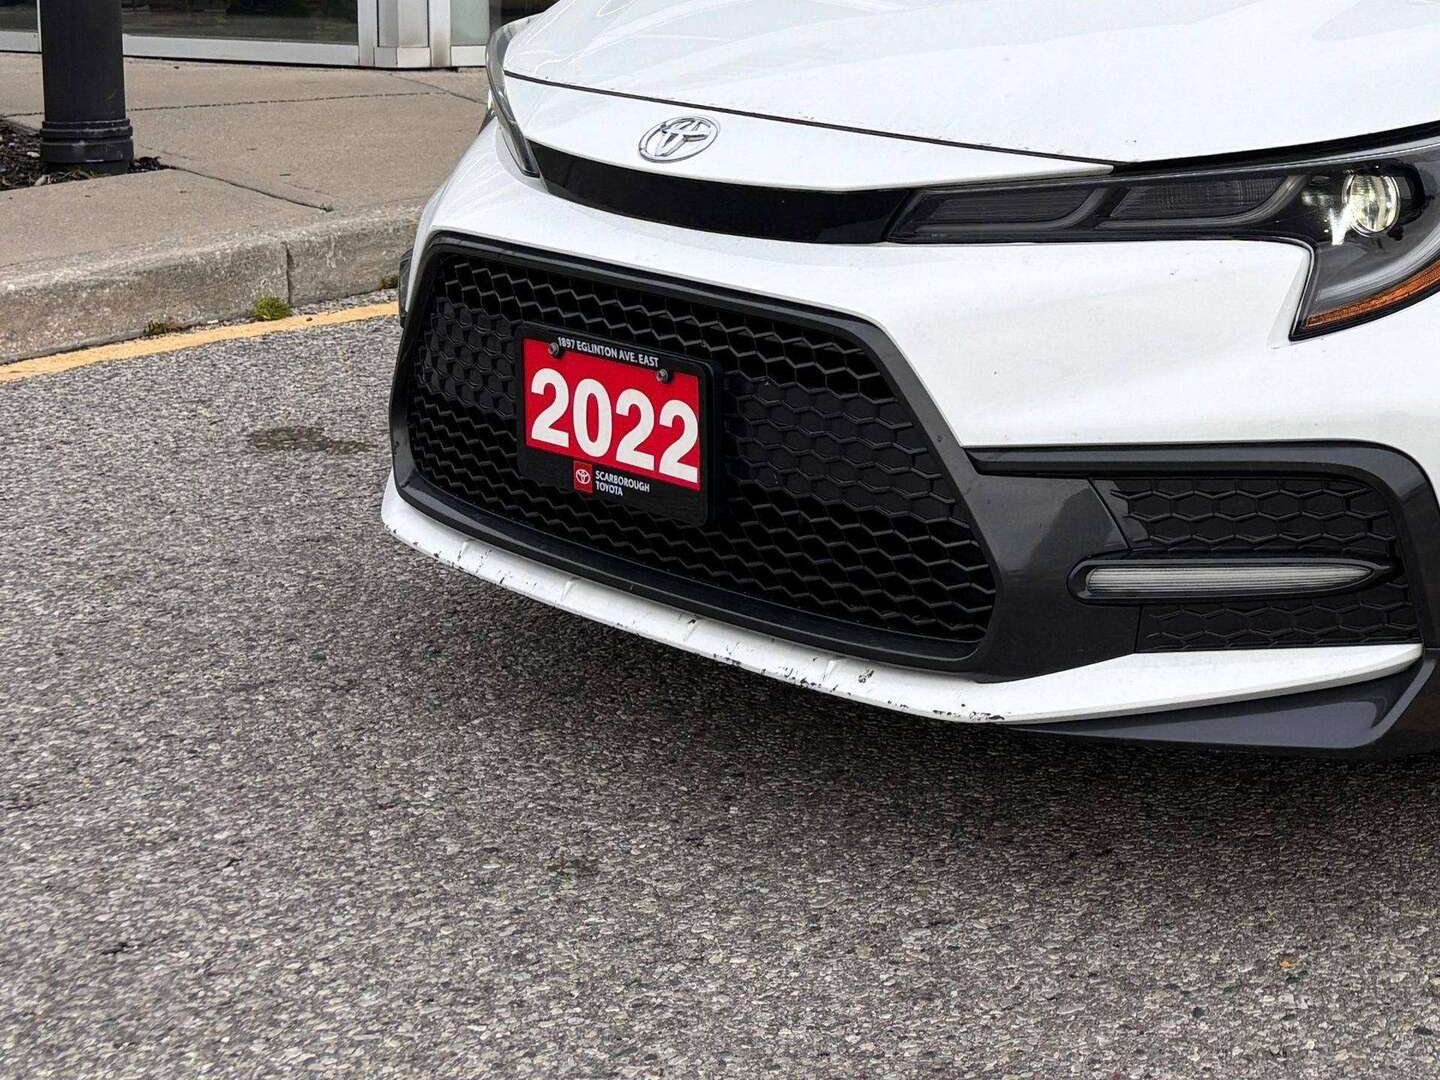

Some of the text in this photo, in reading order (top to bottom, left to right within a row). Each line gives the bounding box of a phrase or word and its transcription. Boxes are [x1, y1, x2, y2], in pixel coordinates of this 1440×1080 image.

[558, 336, 659, 368] 1897 EGLINTON AVE. EAST
[531, 367, 699, 485] 2022
[595, 470, 650, 493] SCARBOROUGH
[595, 480, 623, 497] TOYOTA
